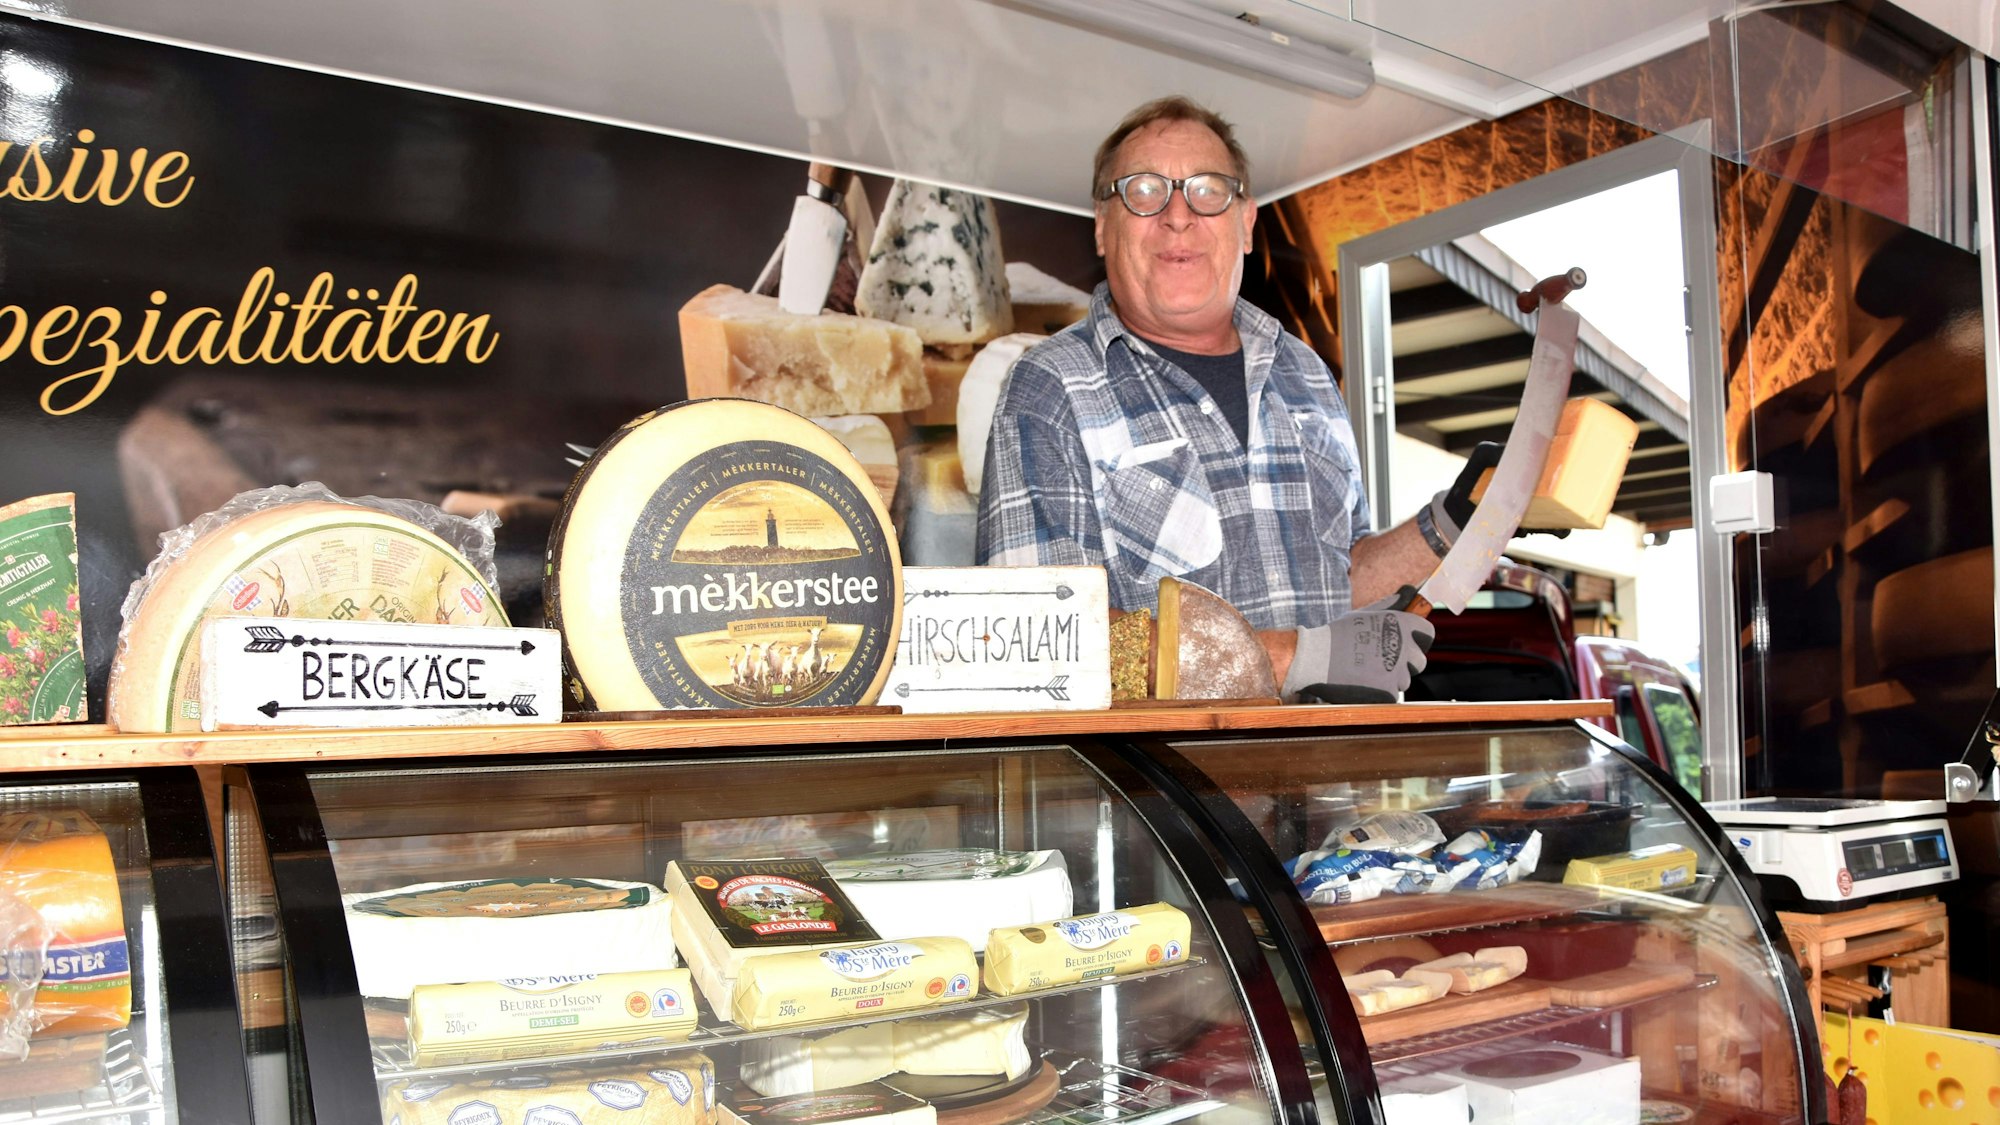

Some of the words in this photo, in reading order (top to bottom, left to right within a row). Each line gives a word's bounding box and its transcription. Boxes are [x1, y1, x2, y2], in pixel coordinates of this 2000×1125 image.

[651, 571, 879, 615] mèkkerstee
[328, 597, 361, 621] ER
[302, 649, 488, 701] BERGKÄSE
[690, 864, 736, 876] PONT
[750, 876, 782, 885] VACHES
[757, 922, 771, 933] LE
[772, 920, 832, 932] GASLONDE
[1098, 924, 1129, 940] Mère
[871, 952, 911, 971] Mère
[857, 998, 883, 1008] DOUX
[778, 1004, 796, 1017] 250g
[445, 1019, 466, 1035] 250g
[531, 1015, 578, 1028] DEMI-SEL
